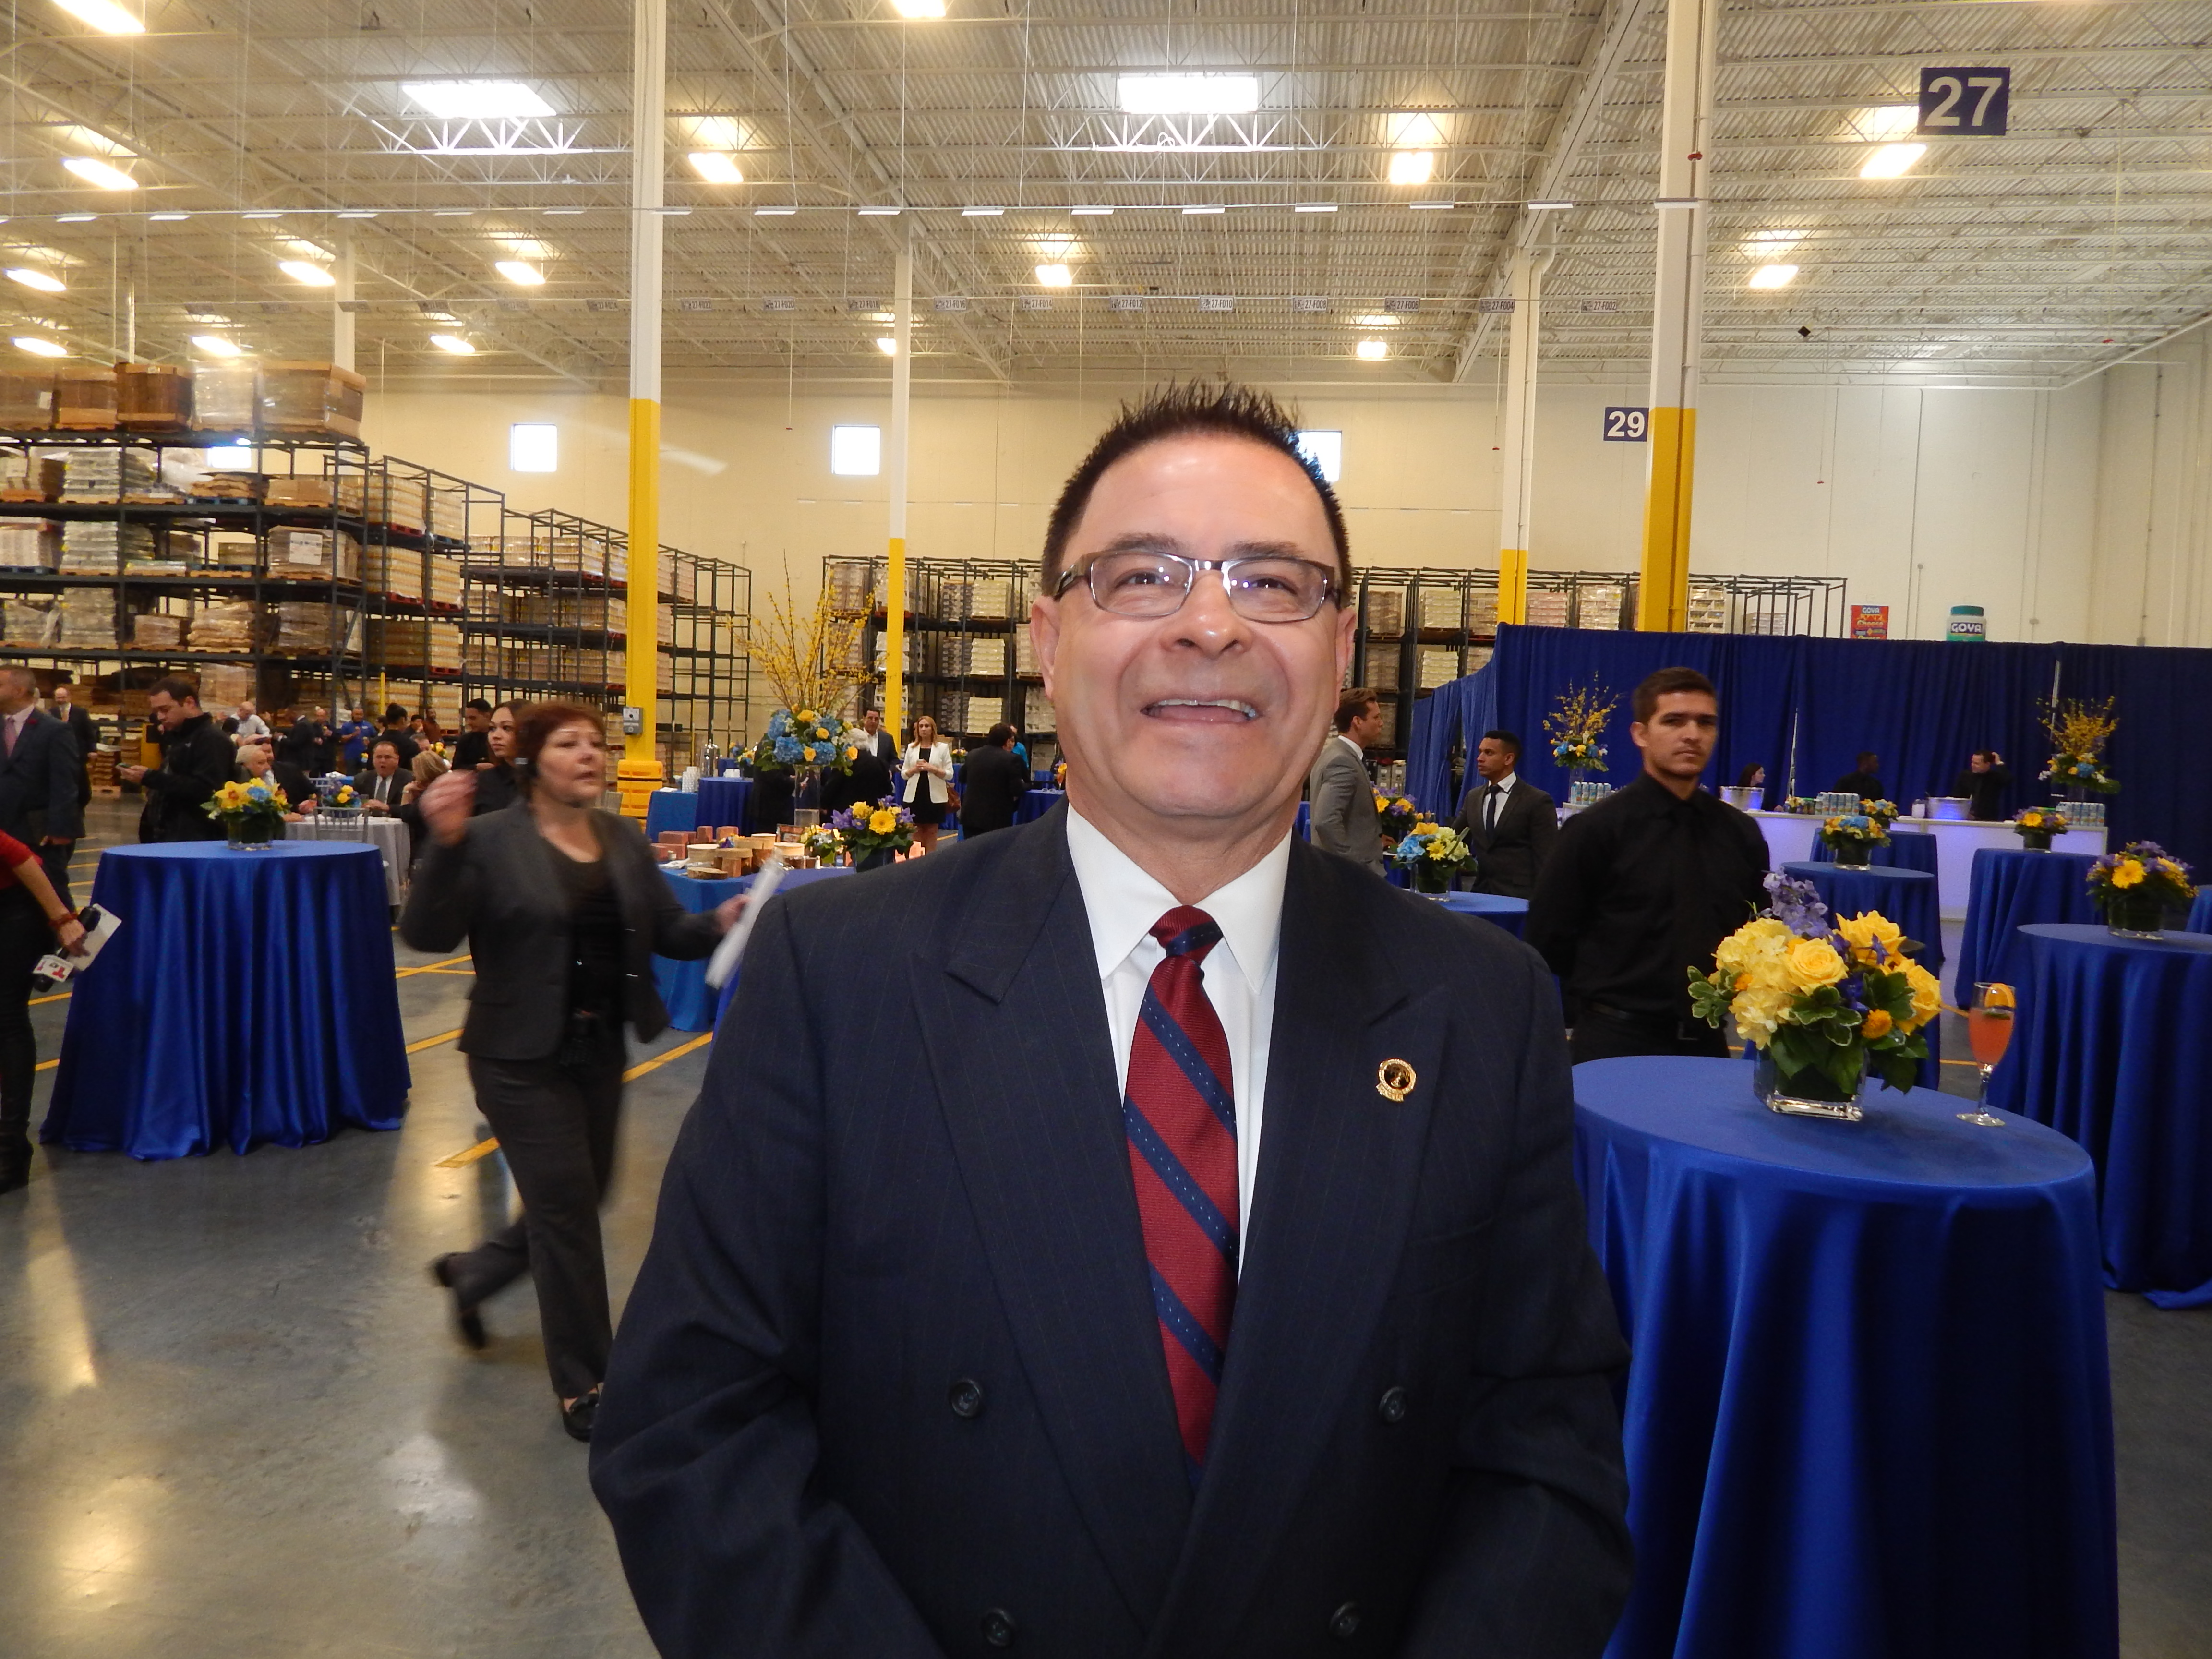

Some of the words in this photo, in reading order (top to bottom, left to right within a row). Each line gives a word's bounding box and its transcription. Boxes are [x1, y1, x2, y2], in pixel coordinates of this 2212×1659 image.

[1925, 76, 2002, 127] 27
[774, 300, 794, 308] 27-F020
[946, 300, 966, 308] 27-F016
[1032, 299, 1053, 308] 27-F014
[1121, 299, 1142, 308] 27-F012
[1211, 299, 1233, 308] 27-F010
[1305, 300, 1327, 309] 27-F008
[1396, 301, 1419, 310] 27-F006
[1491, 301, 1514, 310] 27-F004
[1593, 301, 1616, 311] 27-F002
[1607, 411, 1646, 438] 29
[1951, 623, 1982, 633] GOYA
